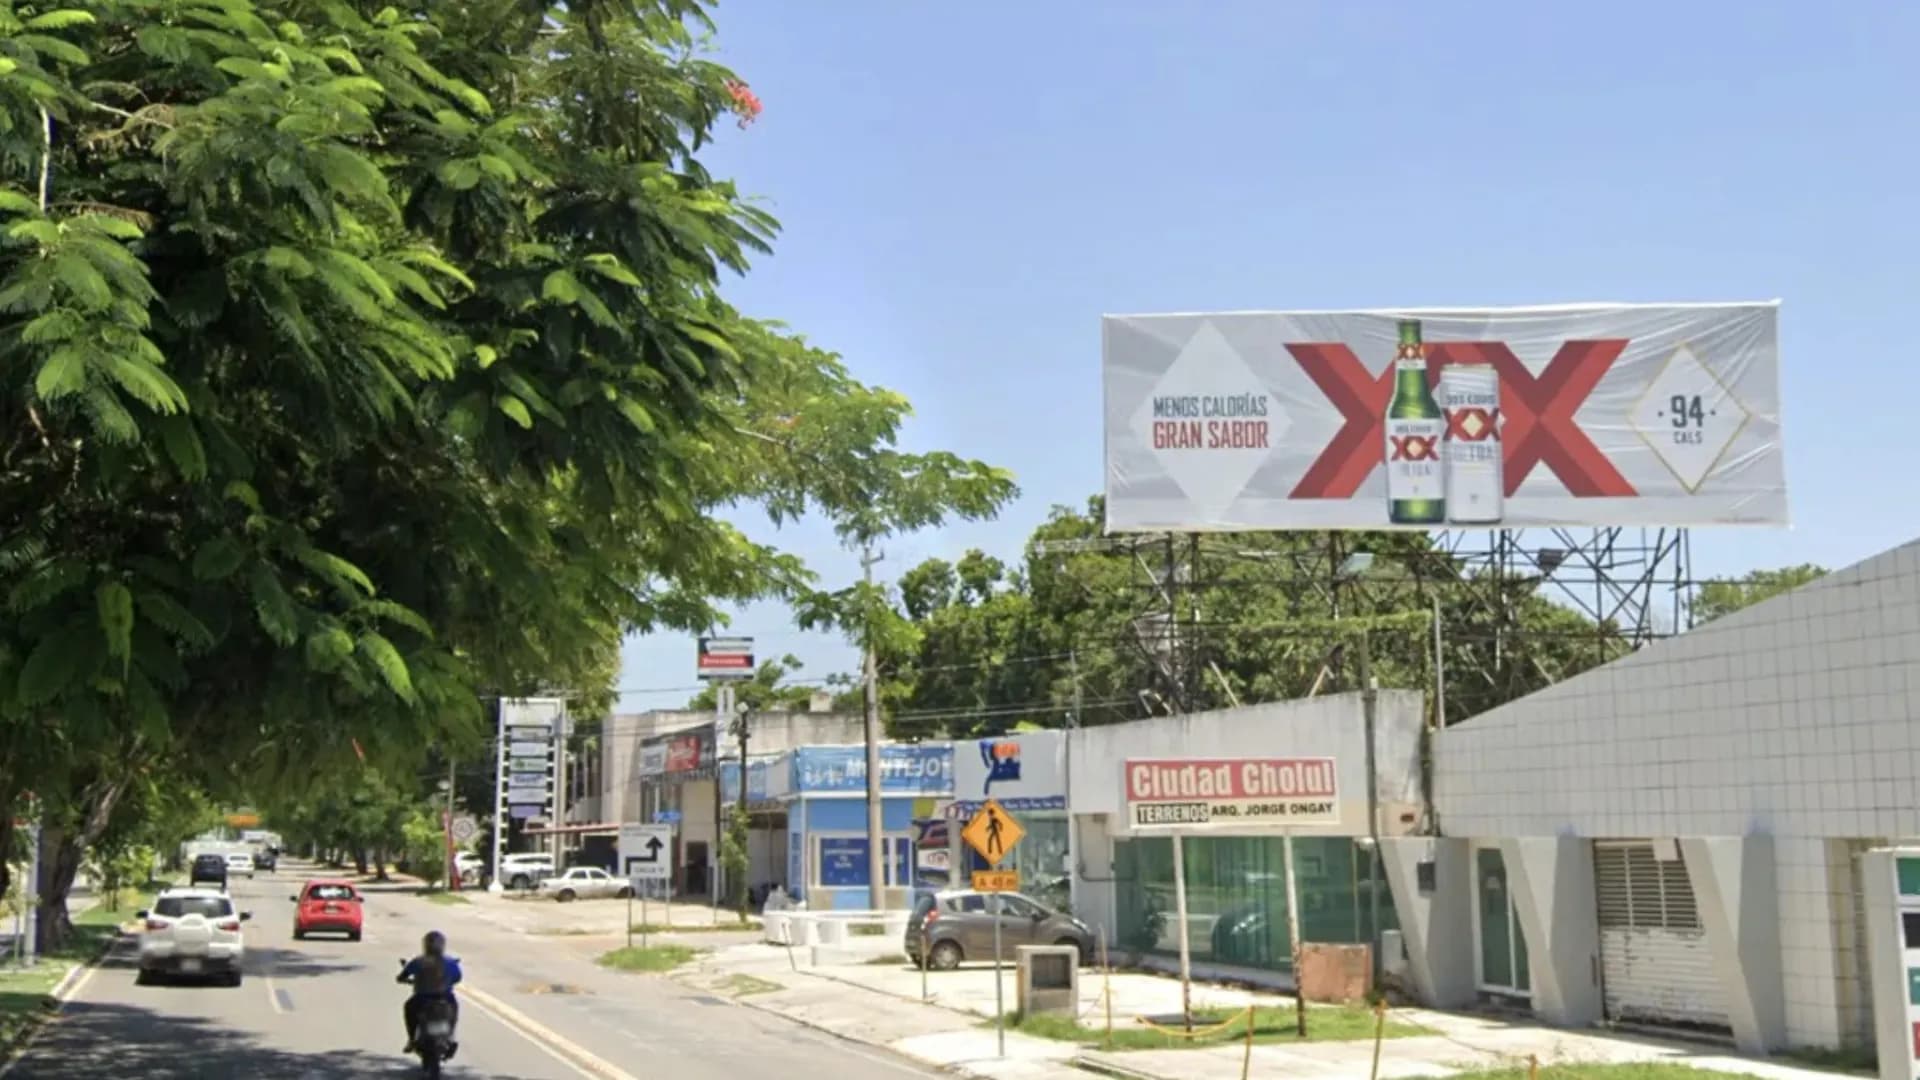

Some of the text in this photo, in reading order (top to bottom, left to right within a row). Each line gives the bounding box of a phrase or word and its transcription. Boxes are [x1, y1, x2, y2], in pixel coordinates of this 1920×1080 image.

[1153, 393, 1268, 417] MENOS CALORÍAS
[1671, 395, 1704, 428] 94
[1153, 421, 1269, 448] GRAN SABOR
[1674, 431, 1703, 444] CALS
[1242, 762, 1333, 795] Cholul
[1139, 805, 1208, 823] TERRENOS
[1246, 803, 1286, 814] JORGE
[1292, 803, 1333, 814] ONGAY
